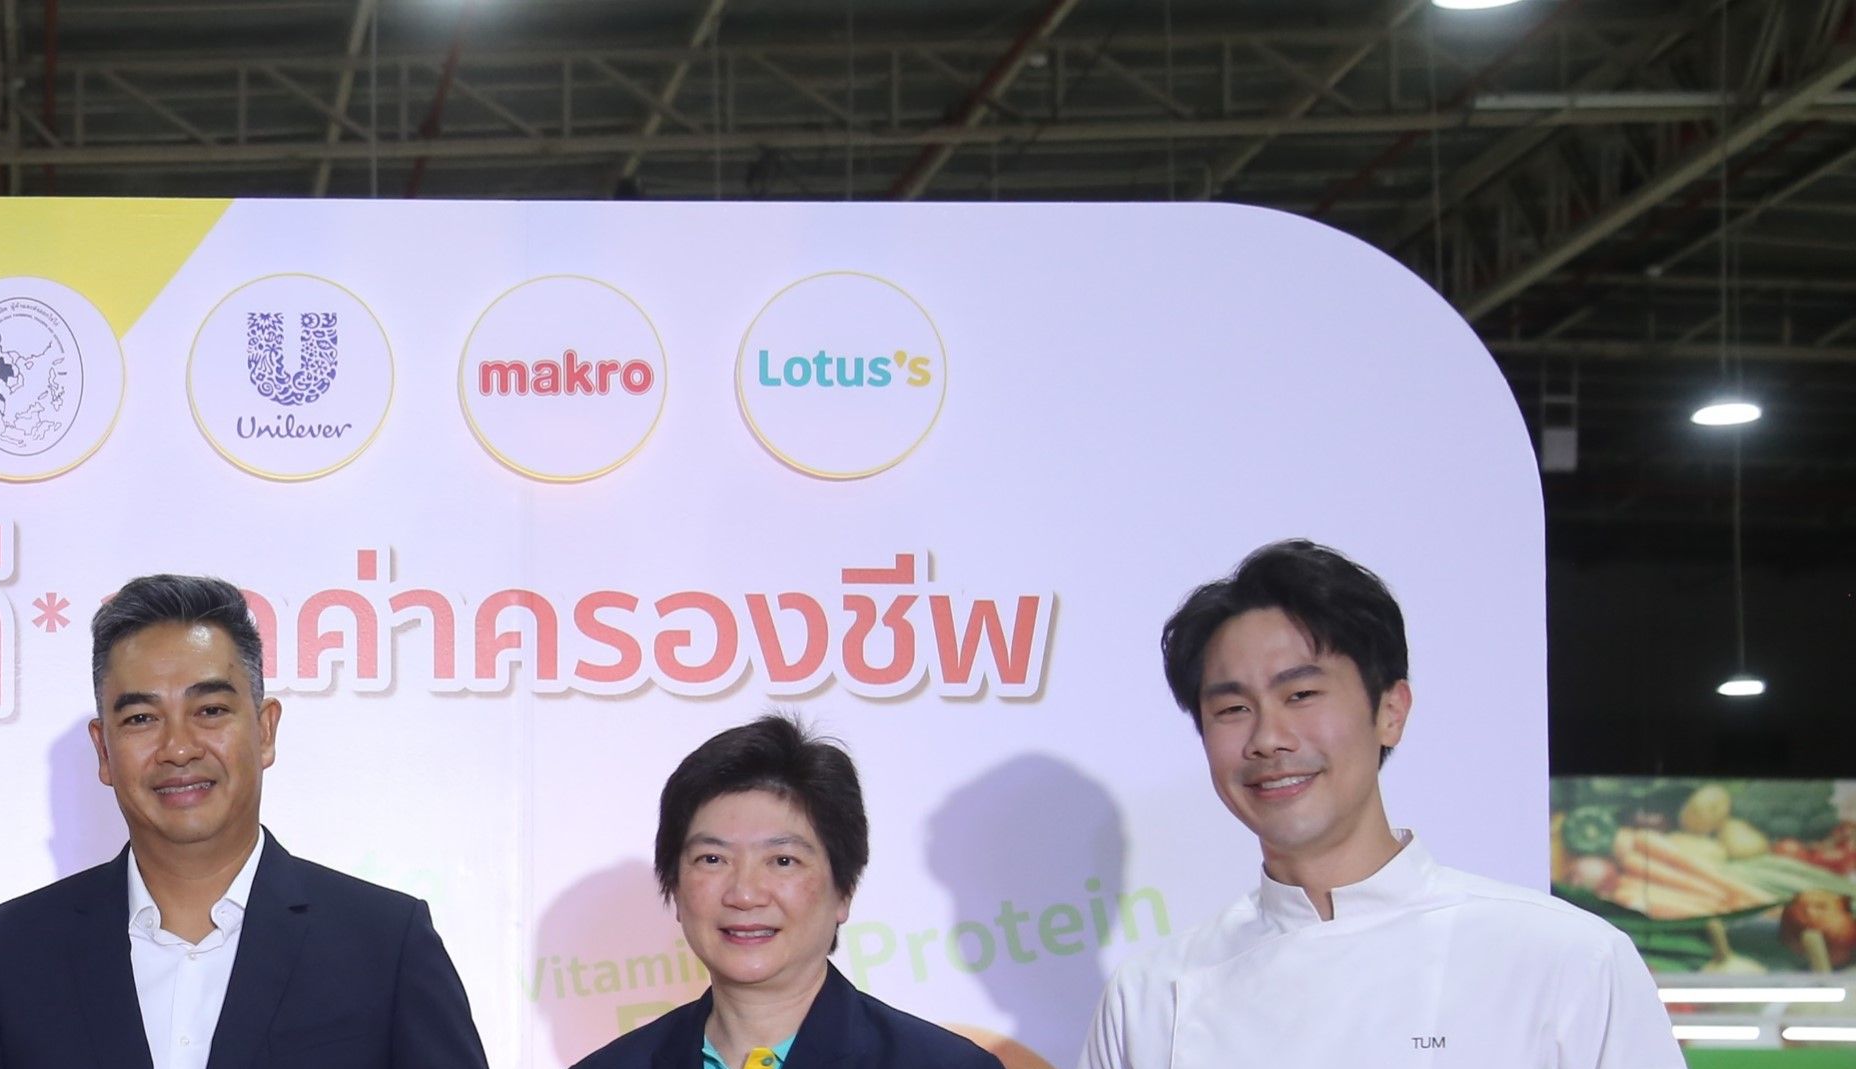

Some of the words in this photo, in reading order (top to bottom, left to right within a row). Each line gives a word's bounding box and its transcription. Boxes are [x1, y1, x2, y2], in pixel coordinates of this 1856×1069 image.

[478, 349, 655, 396] makro
[236, 413, 352, 439] Unilever
[101, 549, 1044, 685] ค่าครองชีพ
[845, 877, 1172, 993] Protein
[1411, 1036, 1446, 1049] TUM
